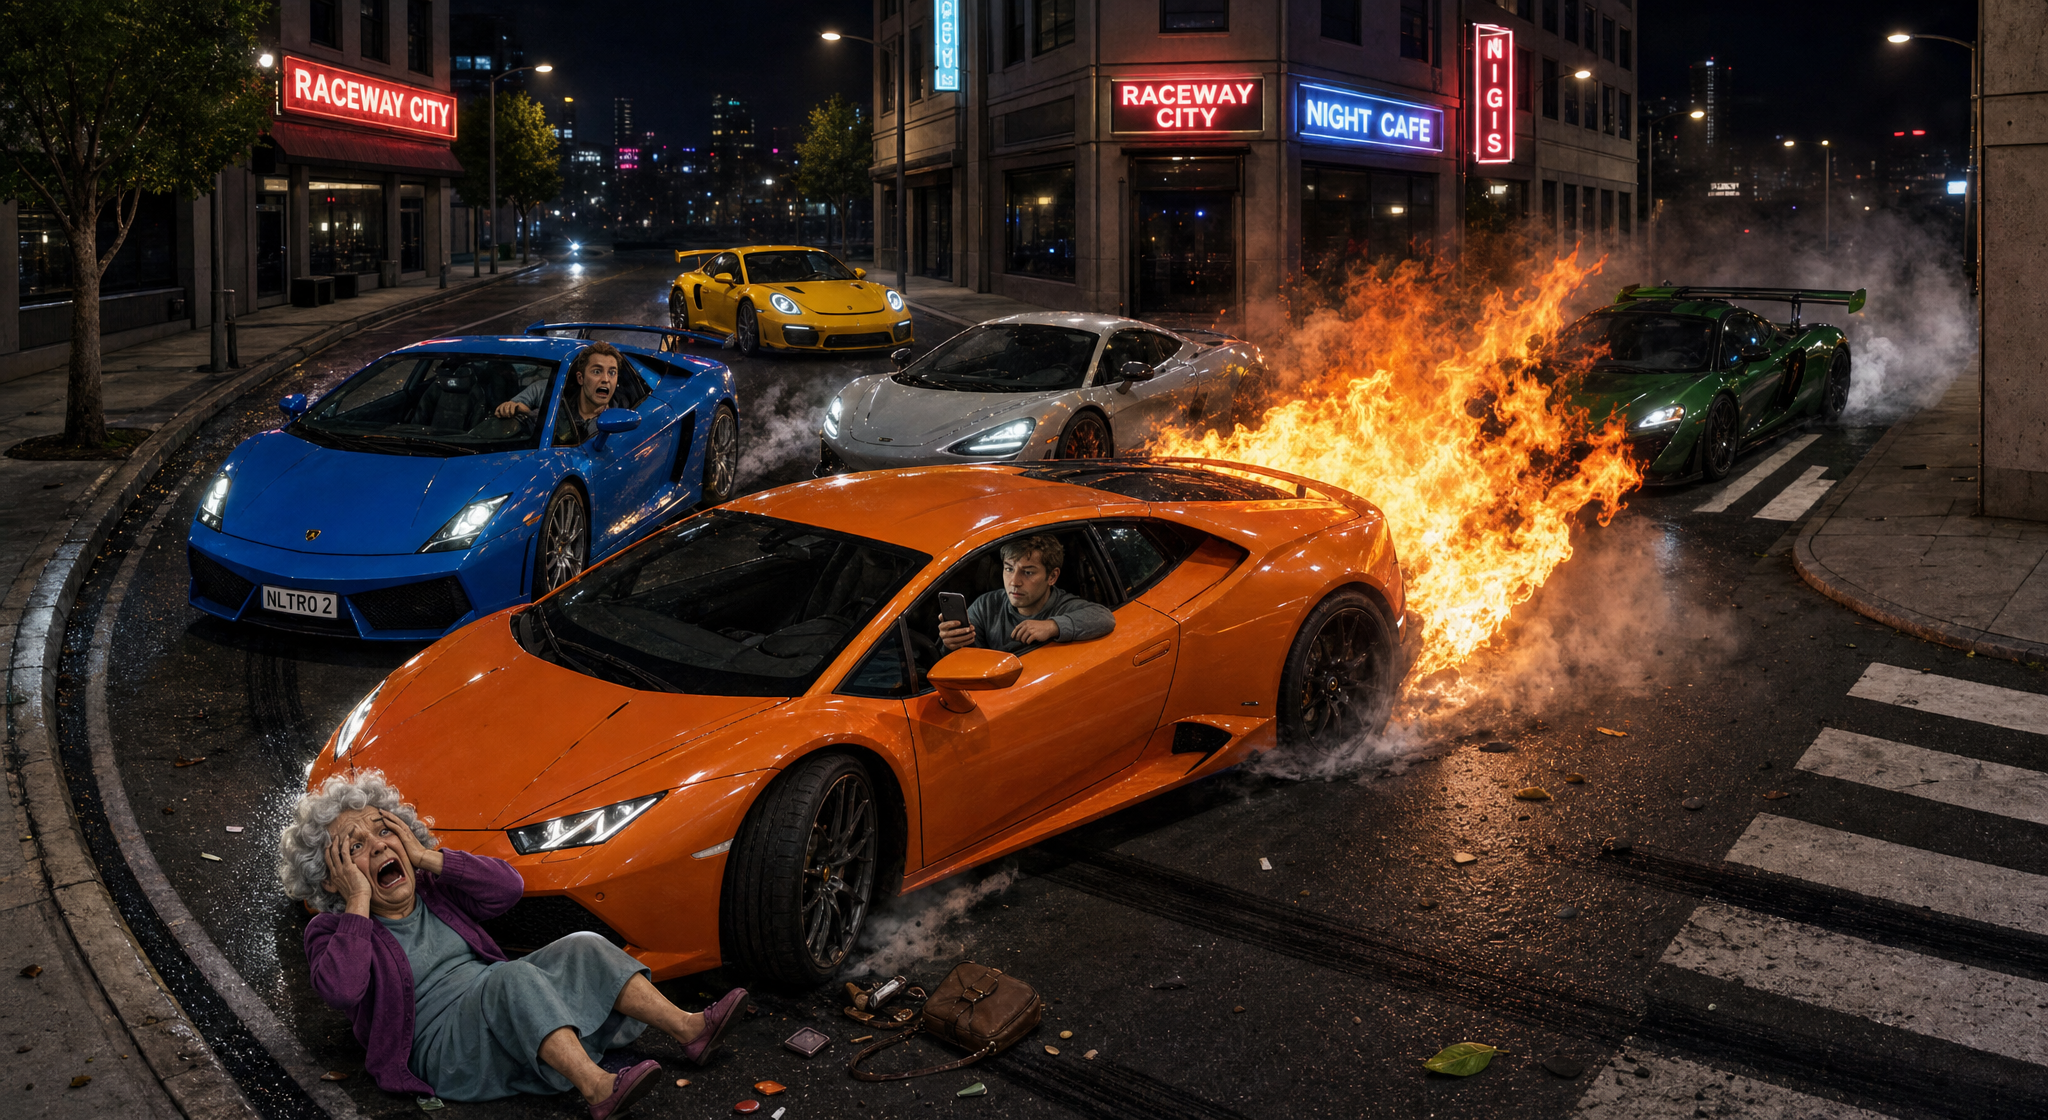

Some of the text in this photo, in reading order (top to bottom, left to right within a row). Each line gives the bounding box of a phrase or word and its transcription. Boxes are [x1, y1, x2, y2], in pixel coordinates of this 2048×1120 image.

[295, 68, 450, 127] RACEWAY CITY
[1122, 84, 1253, 105] RACEWAY
[1156, 107, 1217, 128] CITY
[1307, 99, 1430, 143] NIGHT CAFE
[322, 597, 332, 614] 2
